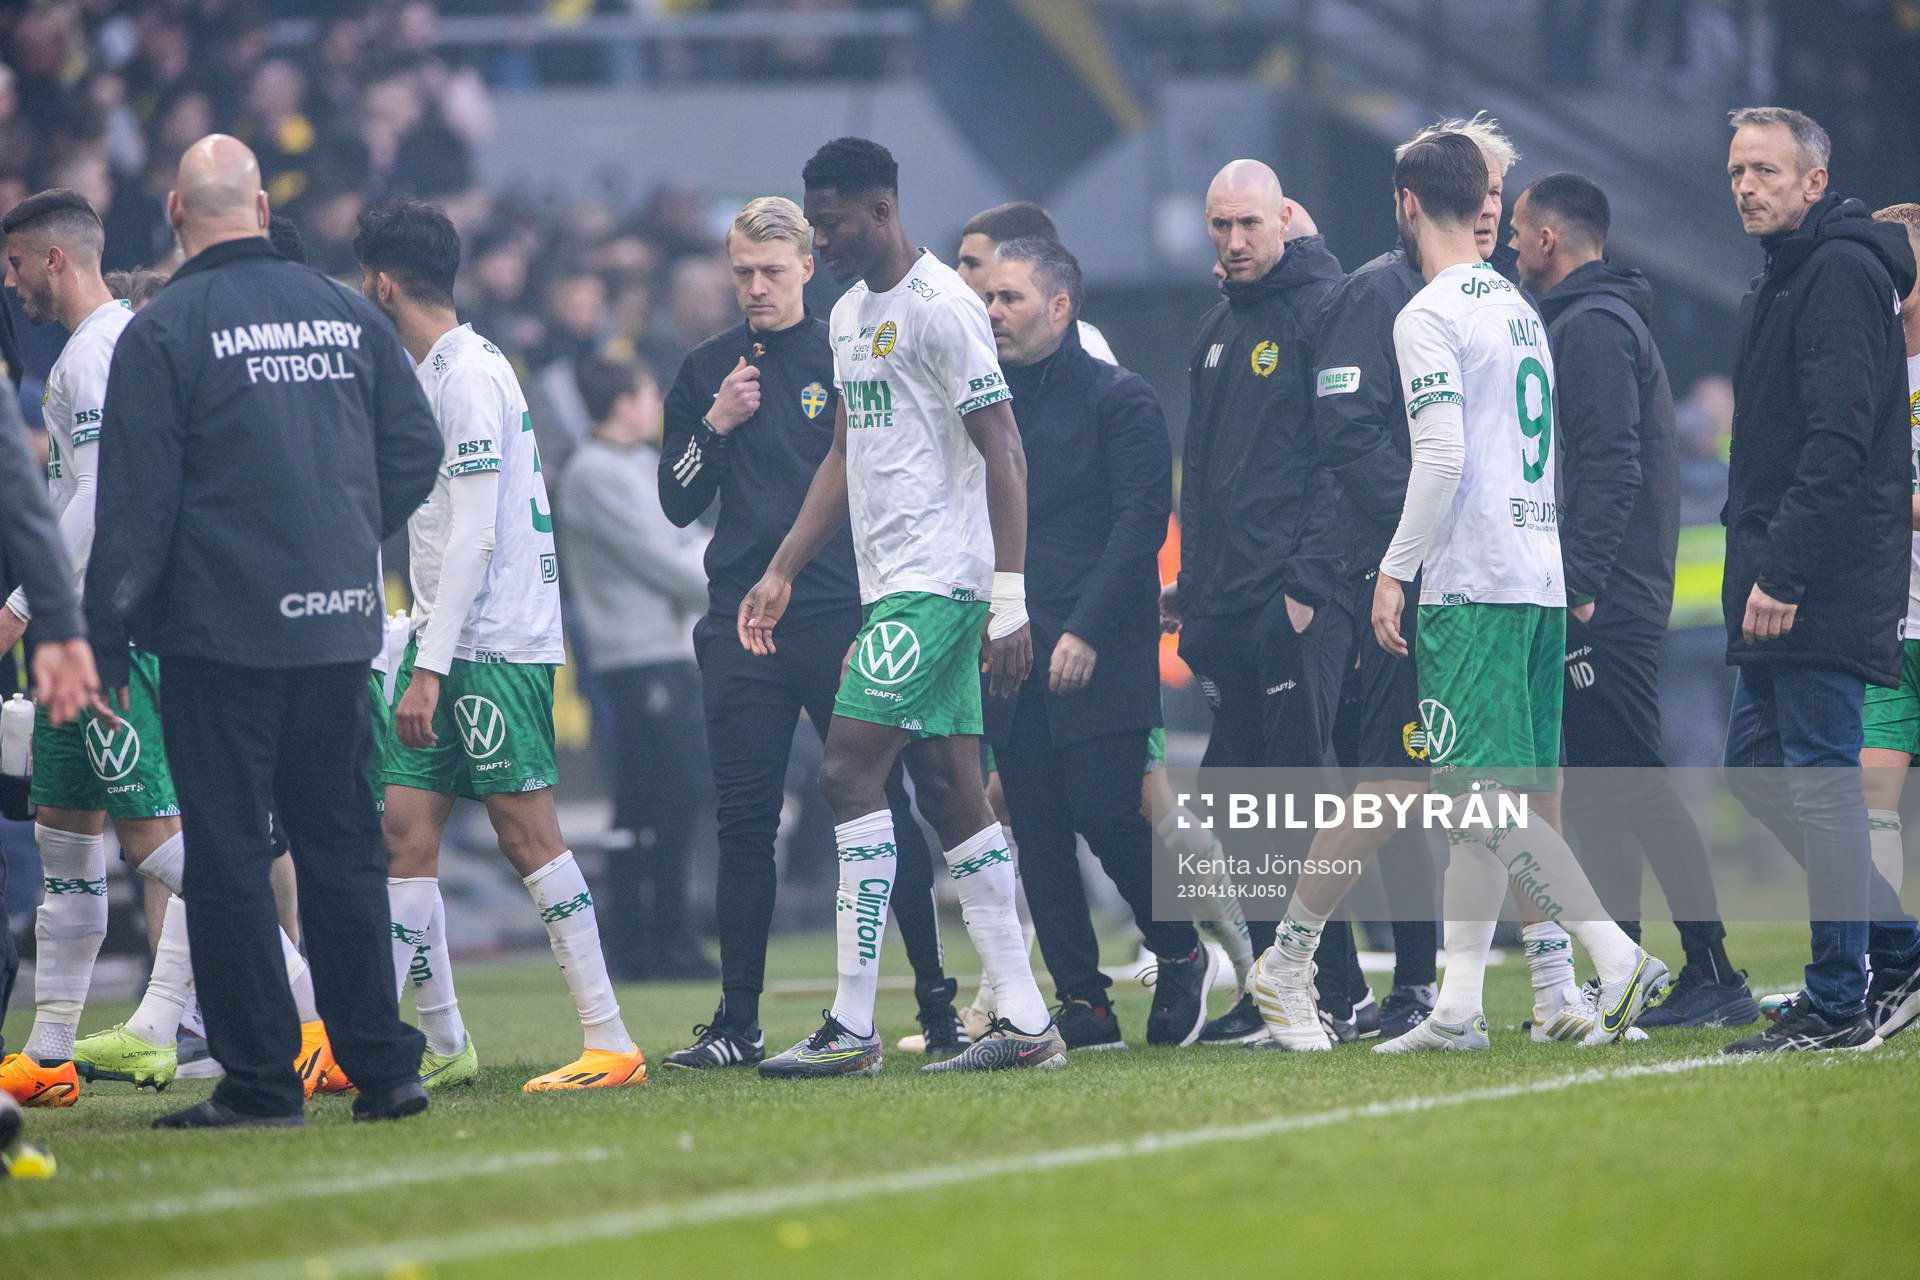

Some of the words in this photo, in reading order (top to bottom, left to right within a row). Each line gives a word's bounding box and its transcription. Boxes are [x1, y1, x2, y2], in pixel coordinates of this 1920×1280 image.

[211, 320, 362, 359] HAMMARBY
[246, 352, 355, 384] FOTBOLL
[1321, 372, 1356, 386] UNIBET
[1411, 372, 1448, 393] BST
[75, 408, 102, 425] BS
[1515, 356, 1551, 484] 9
[458, 440, 492, 456] BST
[280, 589, 366, 619] CRAFT
[1569, 661, 1595, 690] ND
[864, 688, 896, 700] CRAFT
[475, 760, 503, 772] CRAFT
[107, 784, 136, 794] CRAFT
[1508, 851, 1563, 920] Clinton
[856, 878, 890, 959] Clinton
